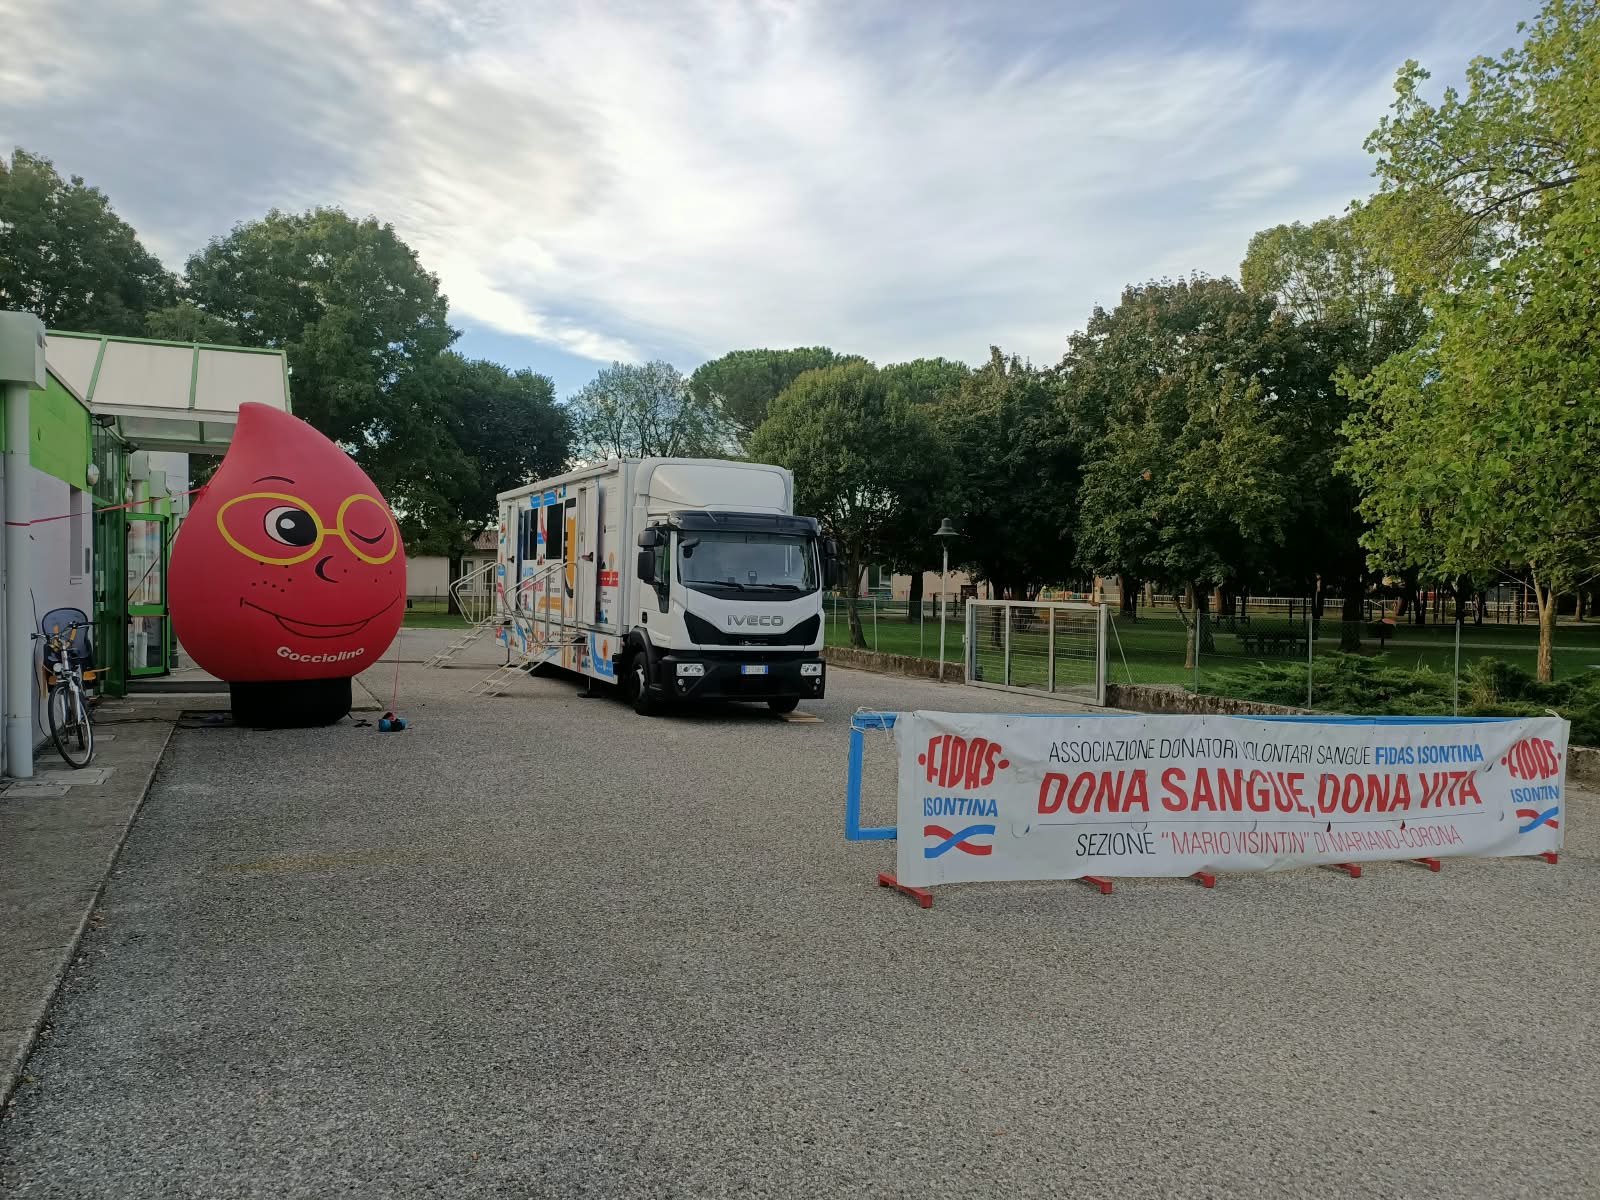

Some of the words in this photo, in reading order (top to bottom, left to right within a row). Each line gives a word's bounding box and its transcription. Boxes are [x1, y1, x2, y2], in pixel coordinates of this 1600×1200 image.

[727, 614, 784, 626] IVECO
[276, 646, 365, 663] Gocciolino
[1049, 738, 1155, 763] ASSOCIAZIONE
[1159, 738, 1238, 760] DONATORI
[1239, 740, 1312, 764] VOLONTARI
[1316, 744, 1371, 765] SANGUE
[1375, 745, 1415, 765] FIDAS
[1417, 743, 1484, 764] ISONTINA
[1038, 769, 1150, 814] DONA
[1160, 767, 1316, 818] SANGUE,
[1317, 772, 1411, 813] DONA
[1418, 770, 1482, 809] VITA
[1510, 785, 1560, 803] ISONTIN
[923, 797, 998, 817] ISONTINA
[1076, 832, 1156, 856] SEZIONE
[1314, 832, 1328, 852] DI
[1328, 825, 1463, 852] MARIANO-CORONA
